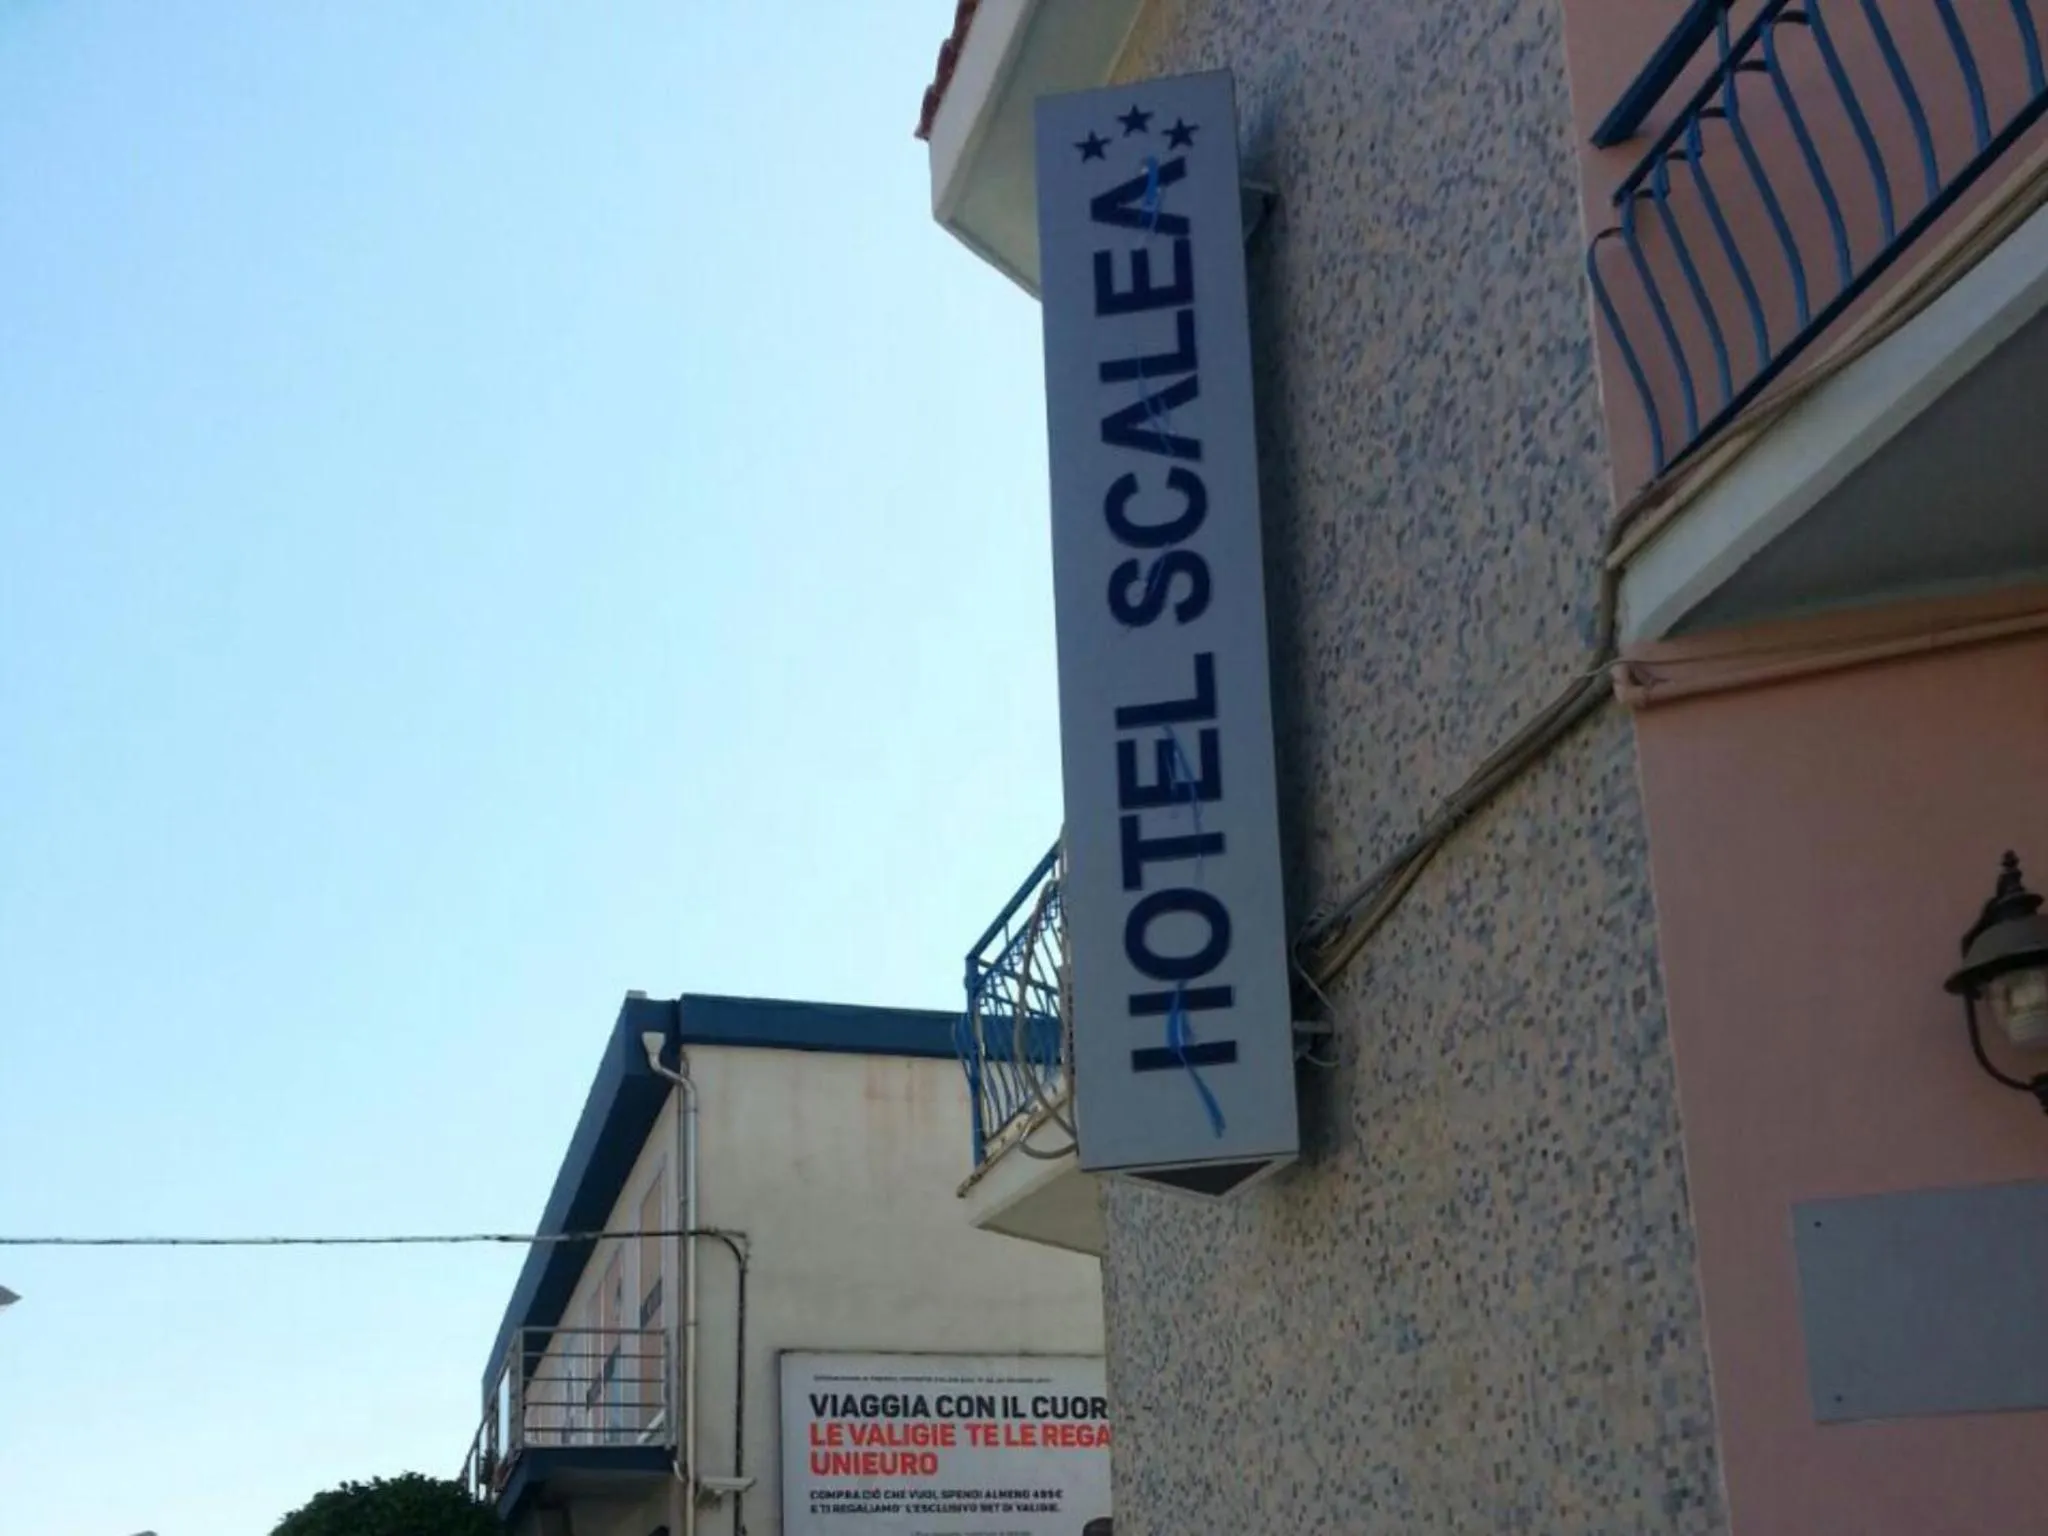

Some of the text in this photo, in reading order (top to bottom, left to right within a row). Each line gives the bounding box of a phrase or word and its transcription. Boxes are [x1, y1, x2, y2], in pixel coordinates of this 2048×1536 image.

[1090, 155, 1238, 1072] HOTEL SCALEA
[809, 1394, 1107, 1419] VIAGGIA CON IL CUOR
[810, 1423, 845, 1447] LE
[848, 1423, 956, 1447] VALIGIE
[964, 1423, 1000, 1447] TE
[1005, 1423, 1036, 1447] LE
[810, 1452, 938, 1476] UNIEURO
[810, 1490, 861, 1500] COMPRA
[941, 1489, 983, 1499] SPENDI
[984, 1489, 1029, 1499] ALMENO
